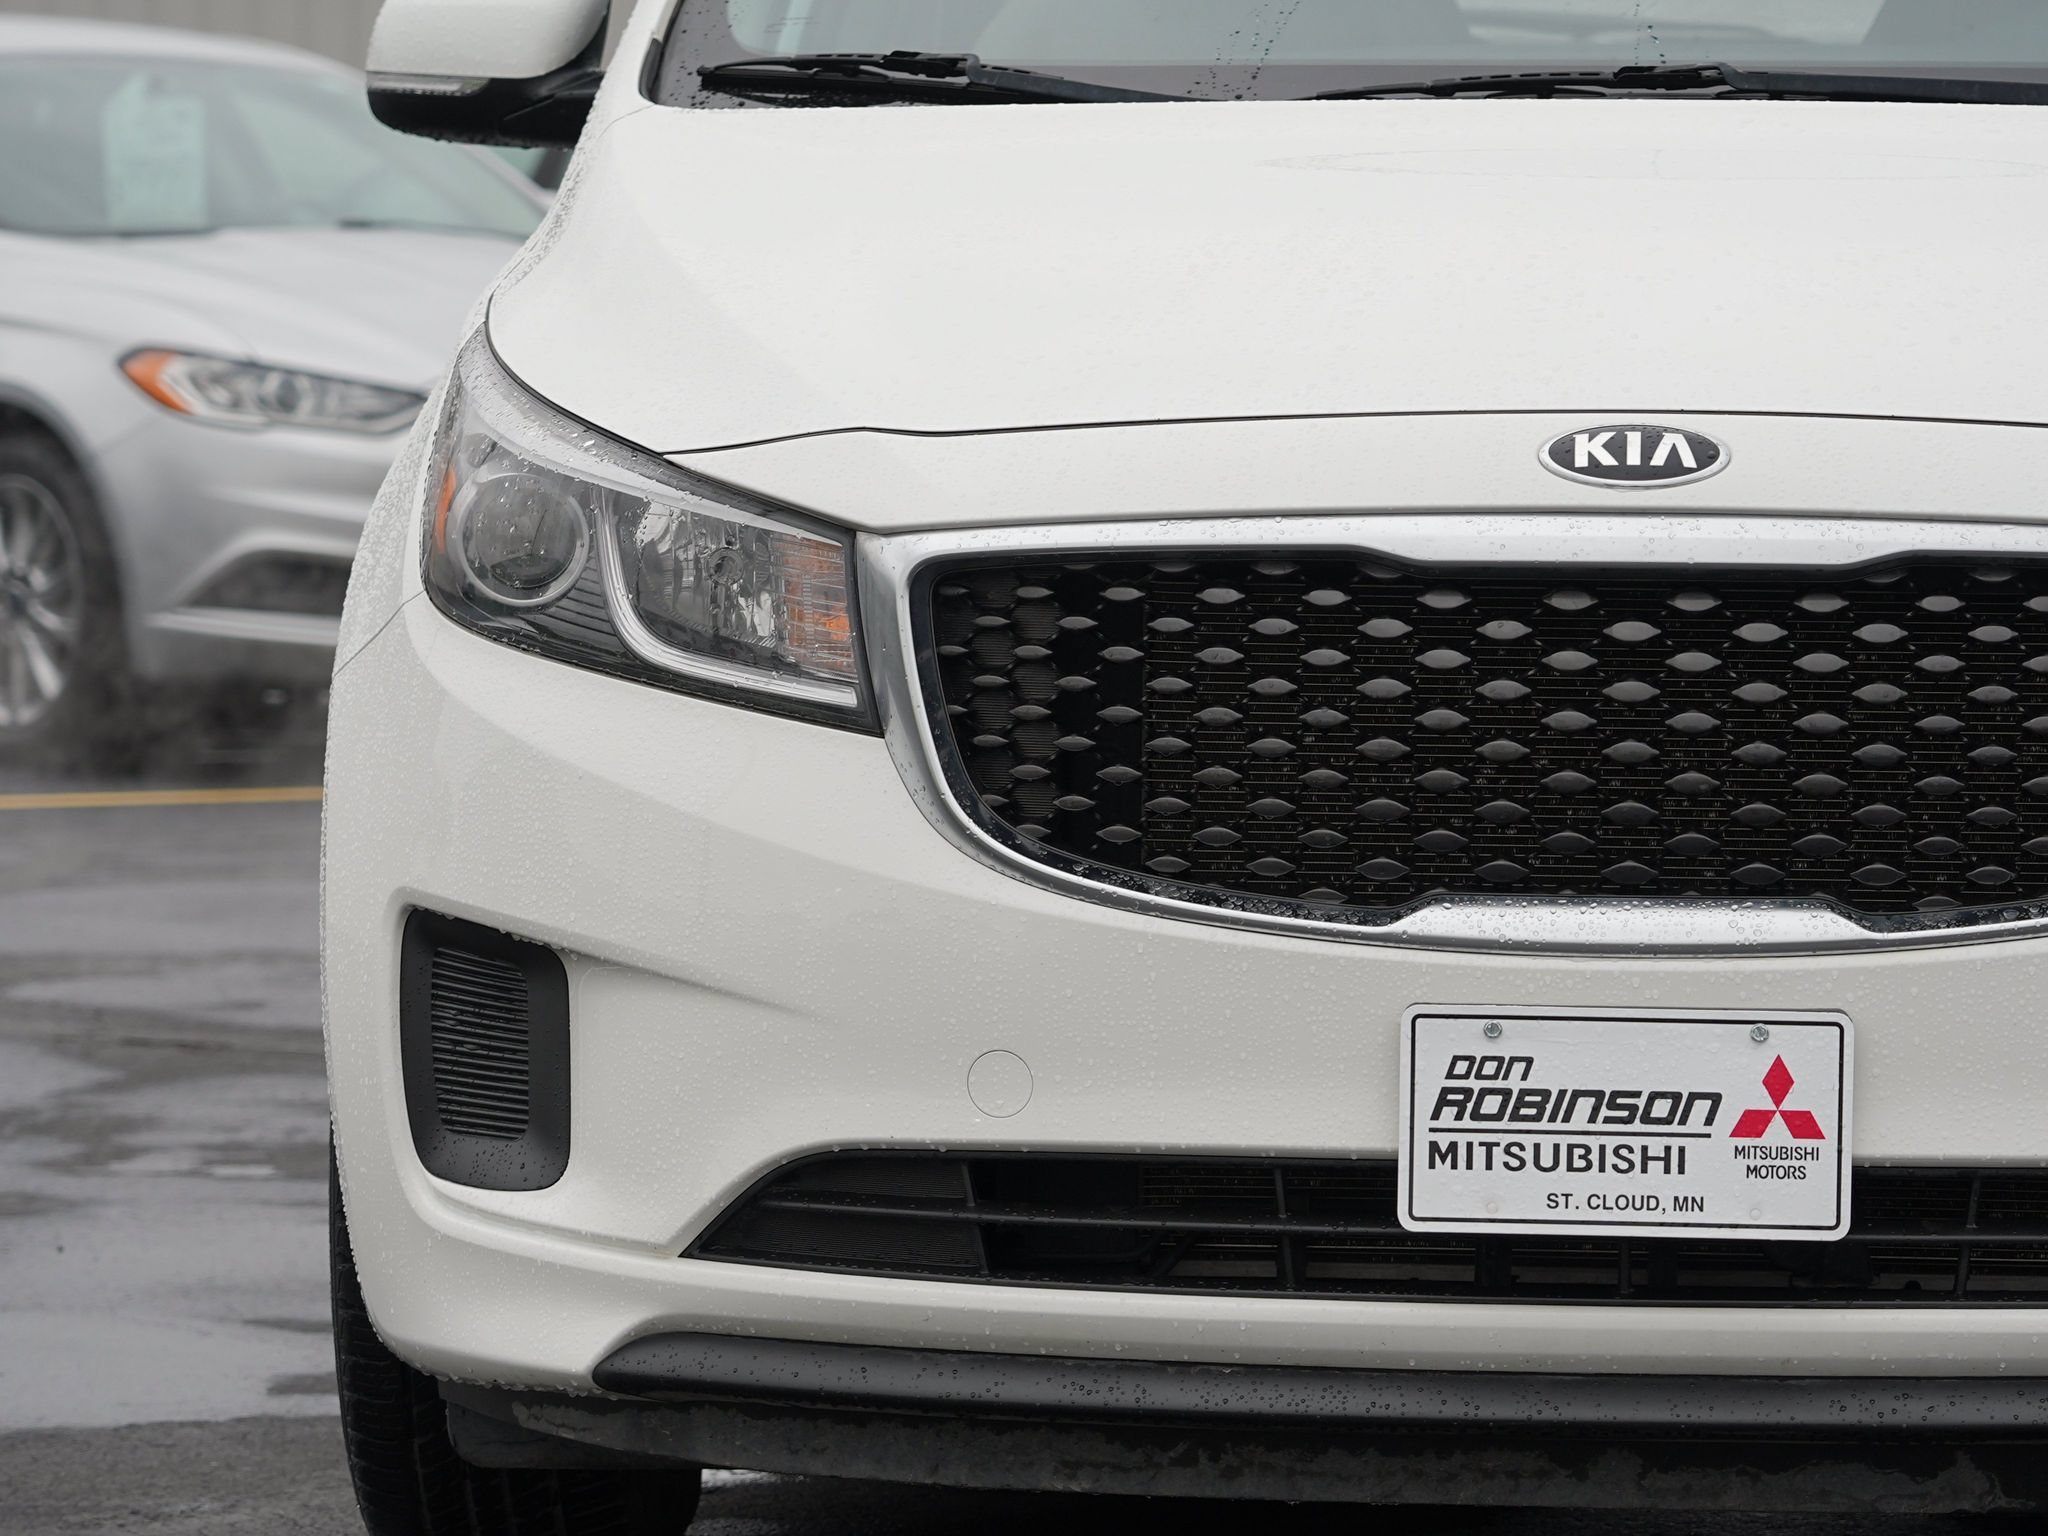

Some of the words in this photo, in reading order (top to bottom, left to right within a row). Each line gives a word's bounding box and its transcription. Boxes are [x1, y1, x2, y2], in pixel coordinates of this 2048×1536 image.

[1572, 431, 1698, 469] KIA
[1427, 1140, 1687, 1176] MITSUBISHI
[1733, 1144, 1821, 1162] MITSUBISHI
[1745, 1164, 1807, 1180] MOTORS
[1545, 1192, 1580, 1211] ST.
[1586, 1193, 1667, 1215] CLOUD,
[1672, 1195, 1705, 1213] MN
